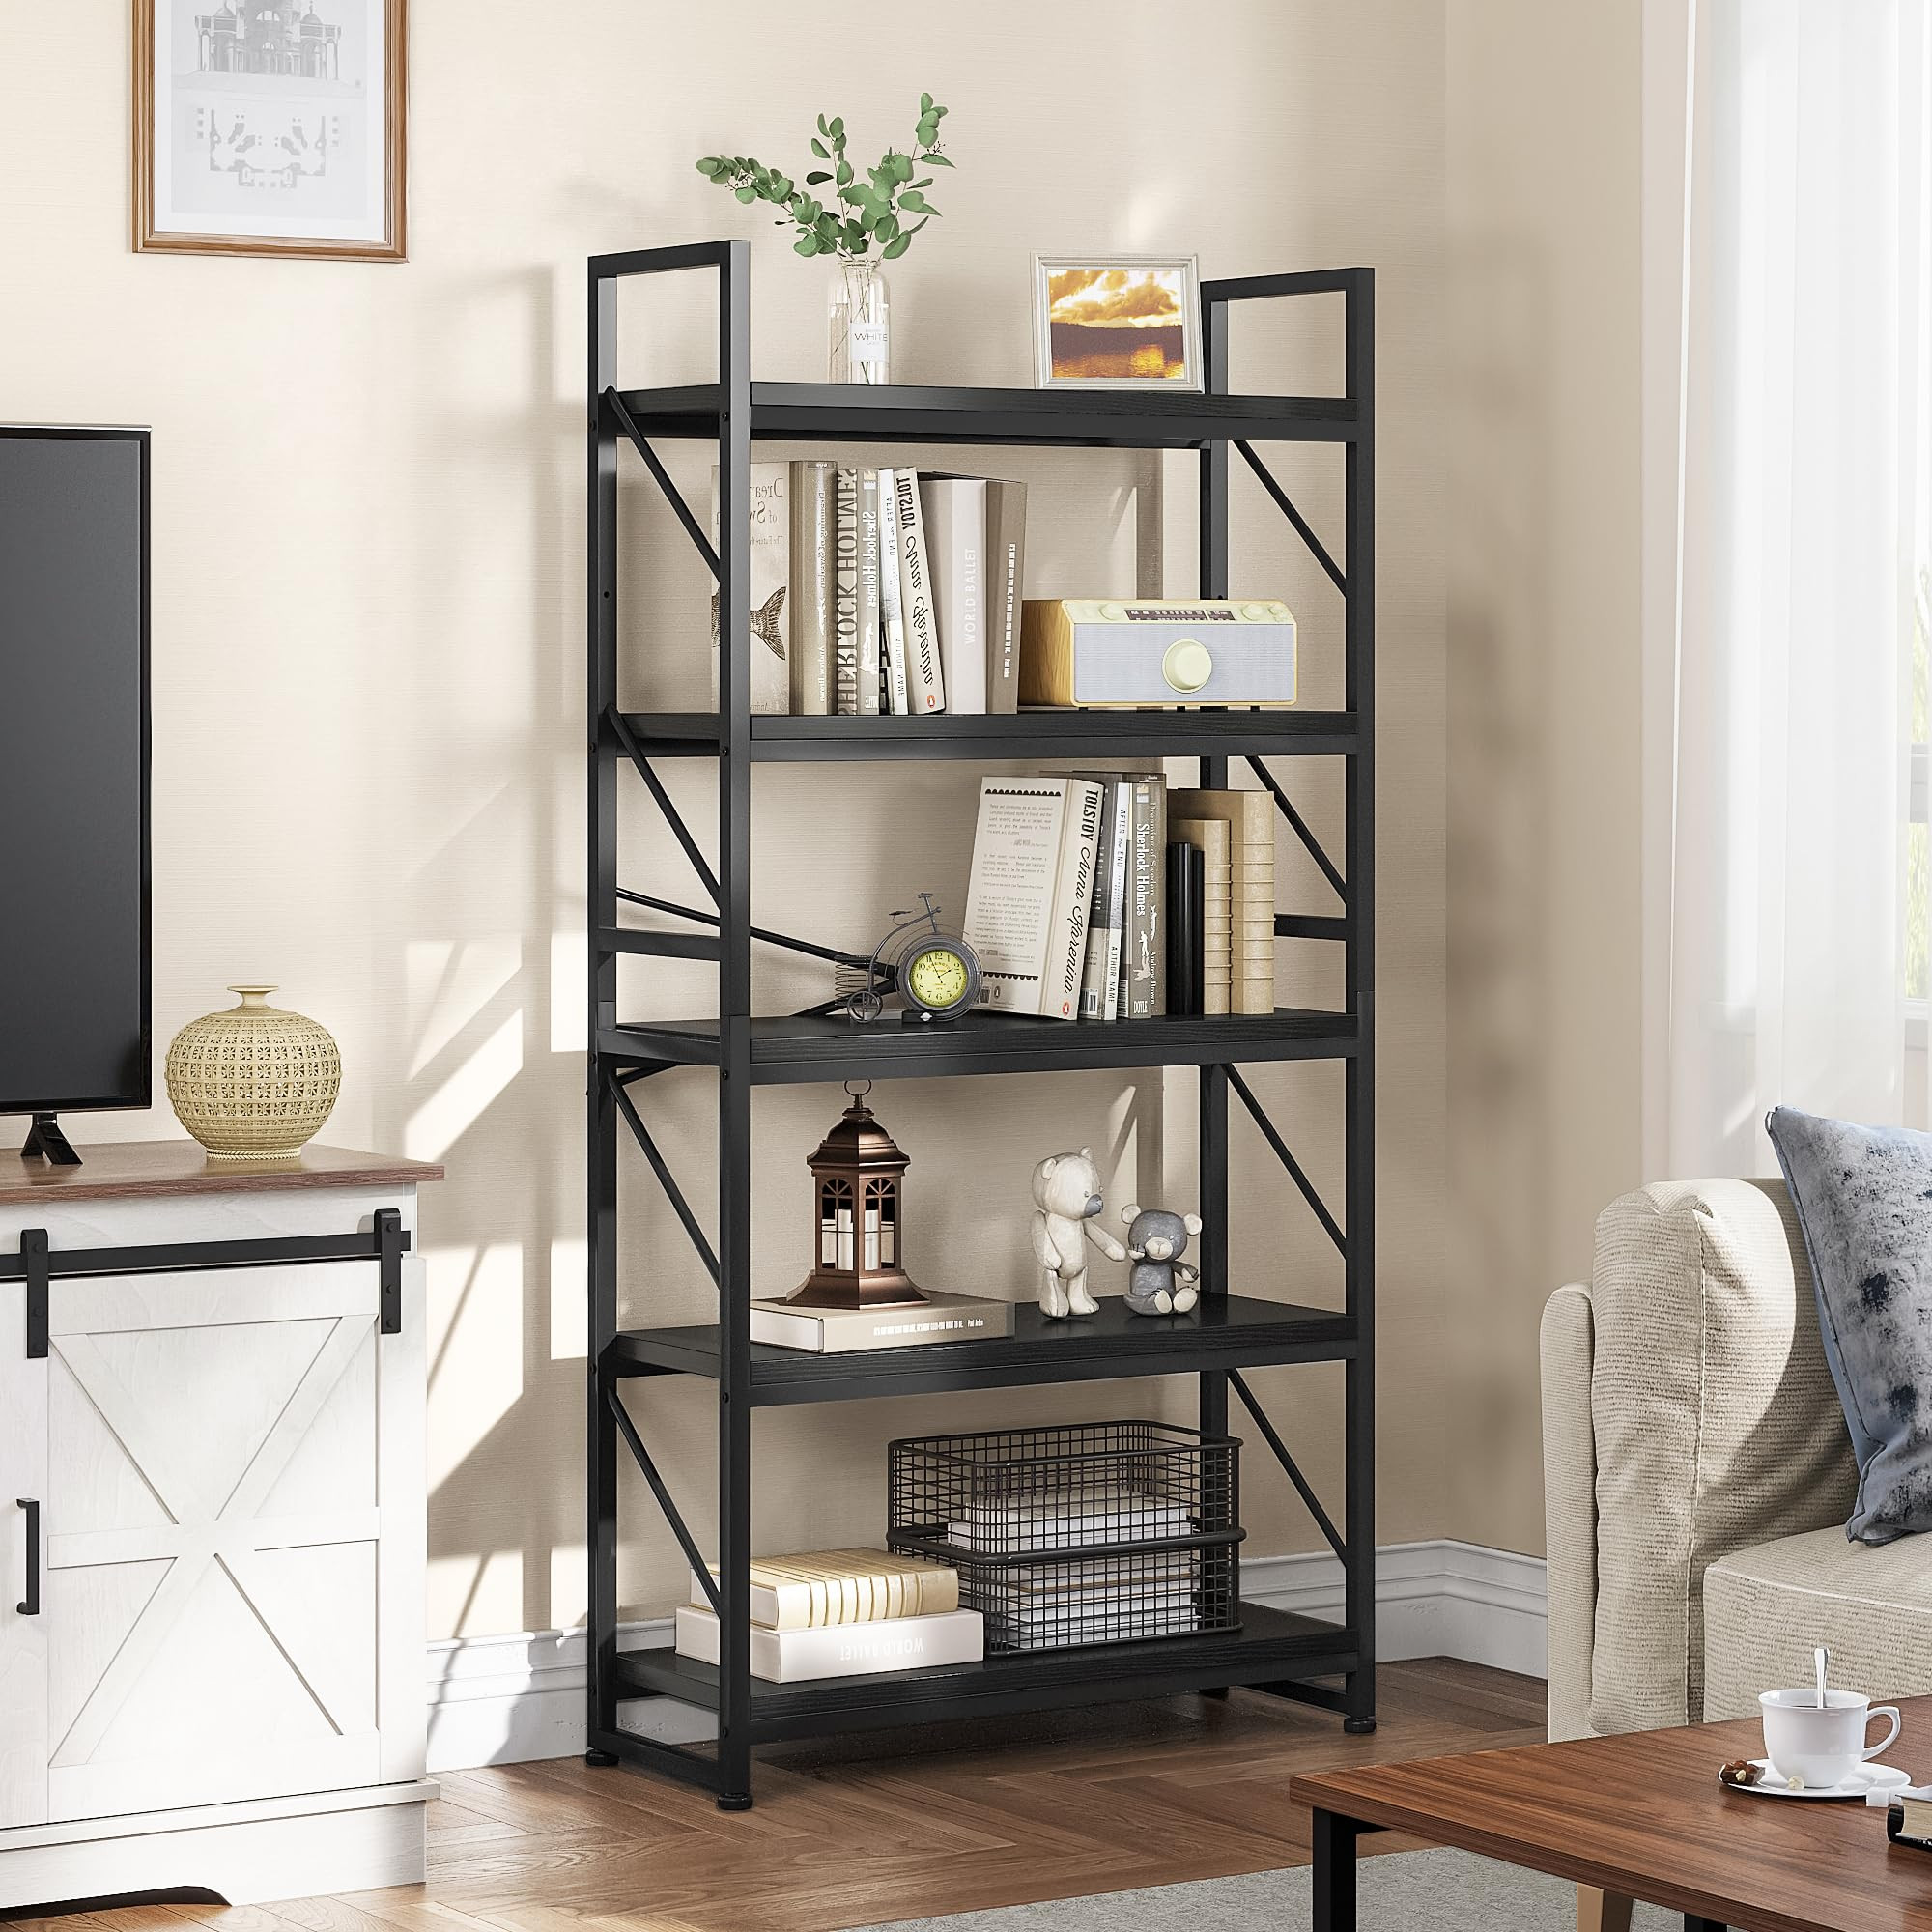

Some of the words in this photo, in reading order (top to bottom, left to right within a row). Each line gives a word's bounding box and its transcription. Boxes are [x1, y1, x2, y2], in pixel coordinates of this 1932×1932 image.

[854, 333, 888, 342] WHITE
[965, 548, 976, 592] BALLET
[964, 598, 976, 645] WORLD
[1081, 789, 1099, 841] TOLSTOY
[1136, 823, 1150, 871] Sherlock
[1075, 847, 1090, 900] Anna
[1136, 875, 1150, 917] Holmes
[1064, 905, 1084, 994] Karenina
